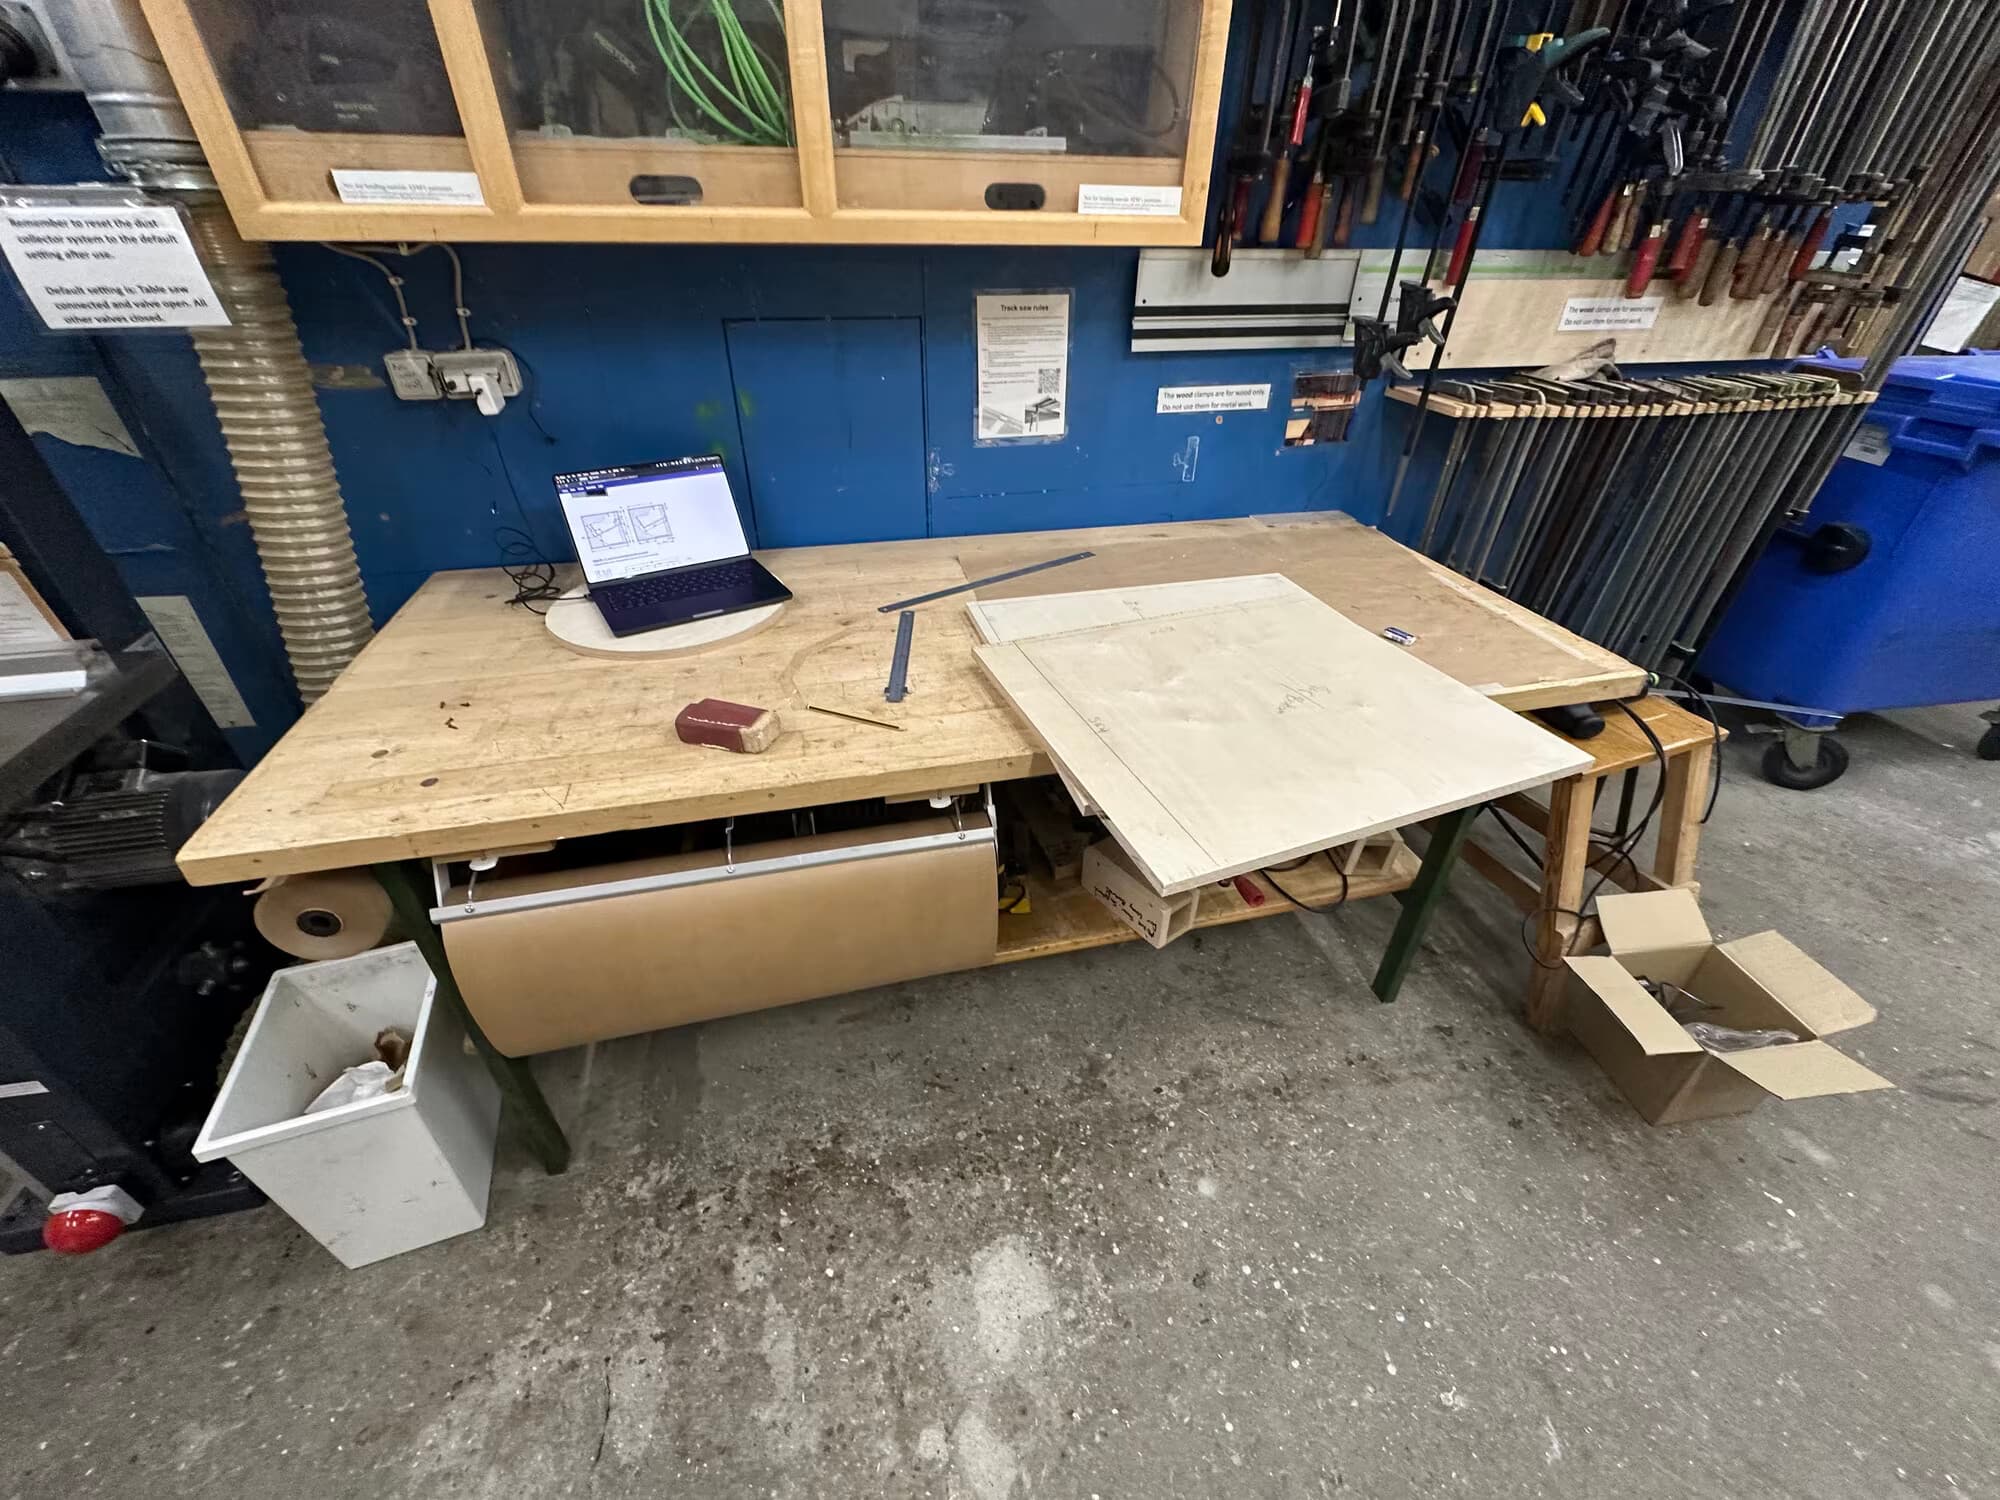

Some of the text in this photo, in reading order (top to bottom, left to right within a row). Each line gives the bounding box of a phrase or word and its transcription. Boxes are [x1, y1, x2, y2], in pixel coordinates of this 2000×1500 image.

[8, 217, 159, 228] Remember to reset the dust
[17, 234, 179, 246] collector system to the default
[25, 251, 64, 261] setting
[65, 250, 89, 259] after
[44, 285, 86, 295] Default
[87, 285, 125, 296] setting
[136, 285, 166, 295] Table
[168, 286, 189, 295] saw
[54, 299, 208, 311] connected and valve open. All
[1000, 304, 1049, 312] Track saw rules
[63, 313, 166, 324] other valves closed.
[1564, 318, 1572, 326] Do
[1176, 391, 1193, 399] wood
[1194, 391, 1214, 399] clamps
[1194, 402, 1210, 410] them
[1220, 401, 1237, 409] metal
